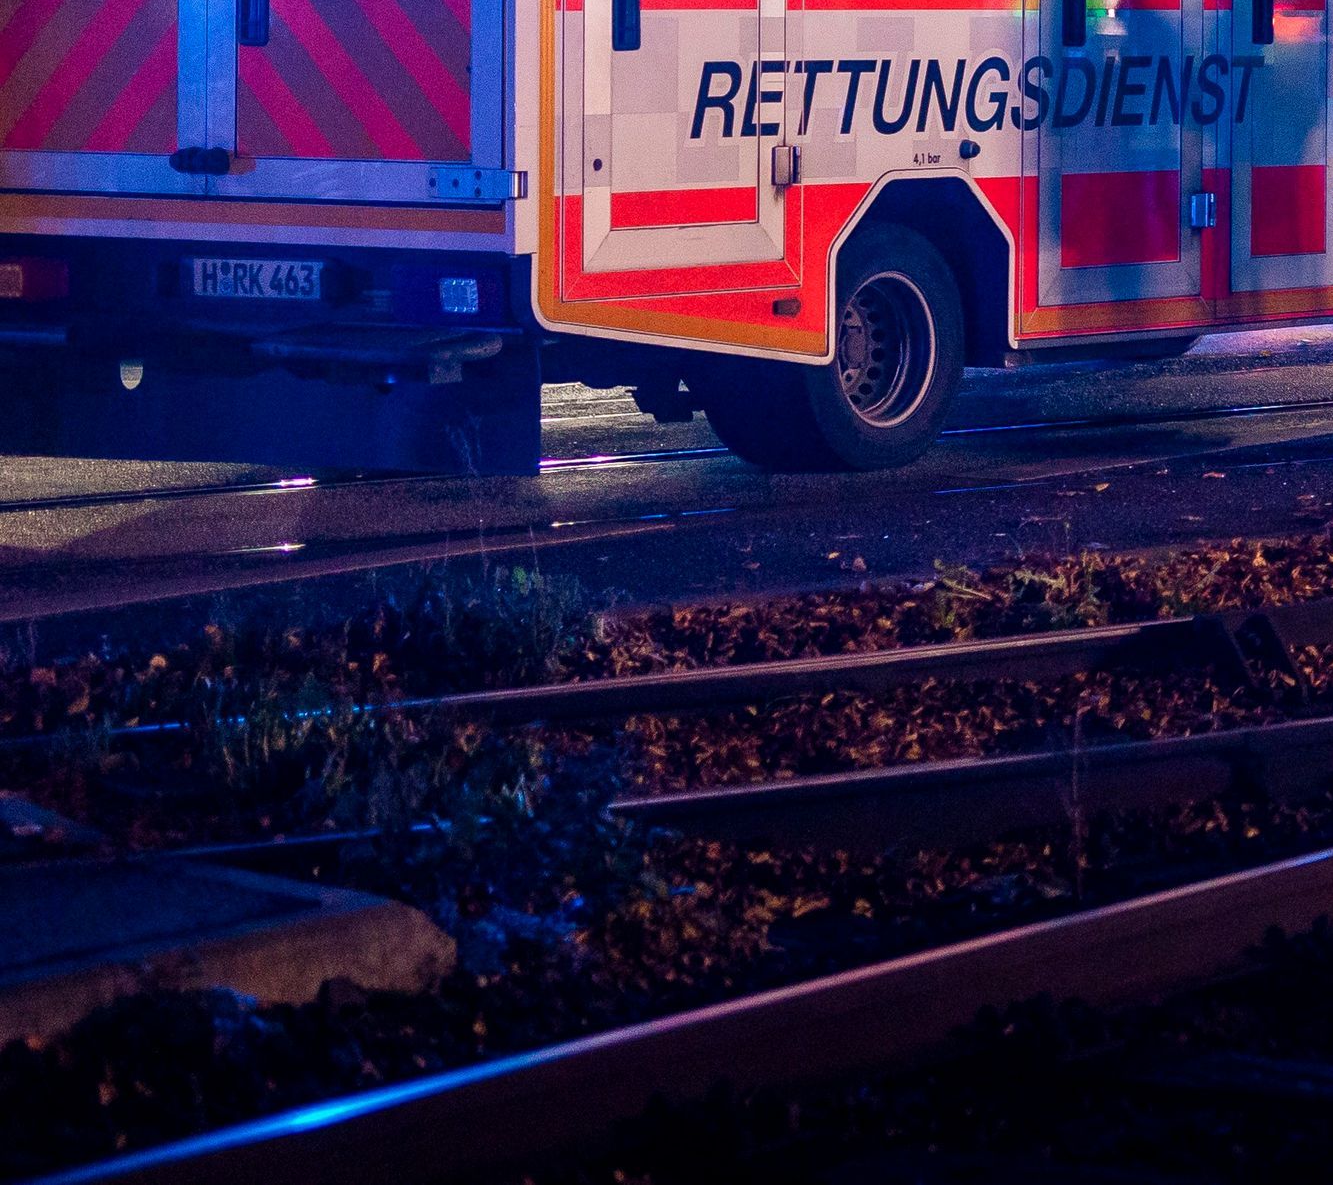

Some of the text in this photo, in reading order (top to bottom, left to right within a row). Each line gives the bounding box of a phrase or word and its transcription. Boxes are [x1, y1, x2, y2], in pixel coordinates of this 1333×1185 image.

[690, 54, 1266, 139] RETTUNGSDIENST
[913, 152, 941, 166] 4,1 bar
[269, 264, 314, 295] 463
